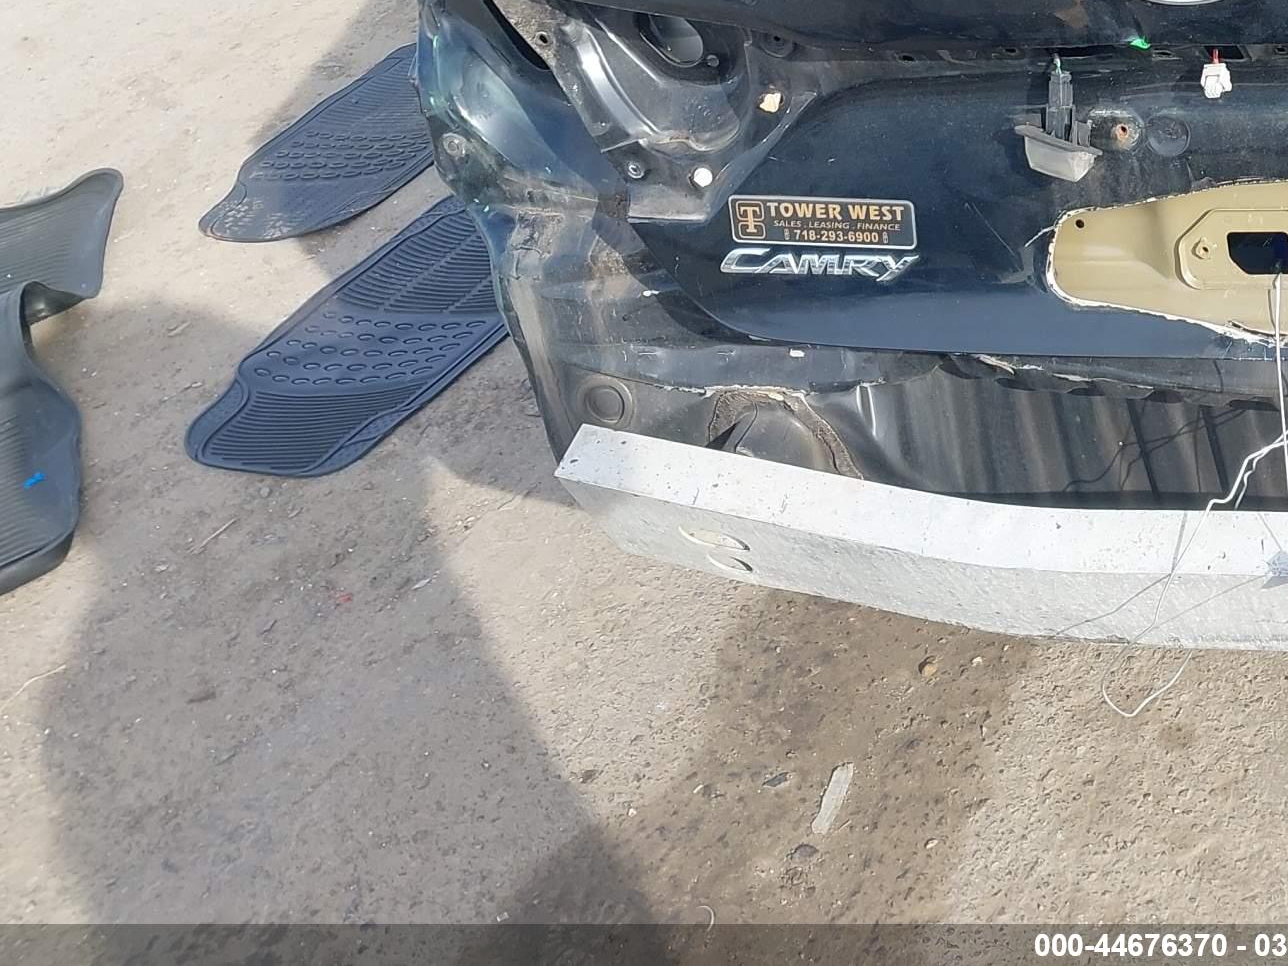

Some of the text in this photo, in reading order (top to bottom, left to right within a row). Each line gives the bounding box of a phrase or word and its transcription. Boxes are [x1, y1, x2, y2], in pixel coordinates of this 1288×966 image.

[766, 202, 904, 221] TOWER WEST
[773, 220, 802, 228] SALES
[808, 221, 850, 229] LEASING
[857, 223, 901, 231] FINANCE
[794, 229, 879, 243] 718-293-6900
[720, 247, 919, 282] CAMRY
